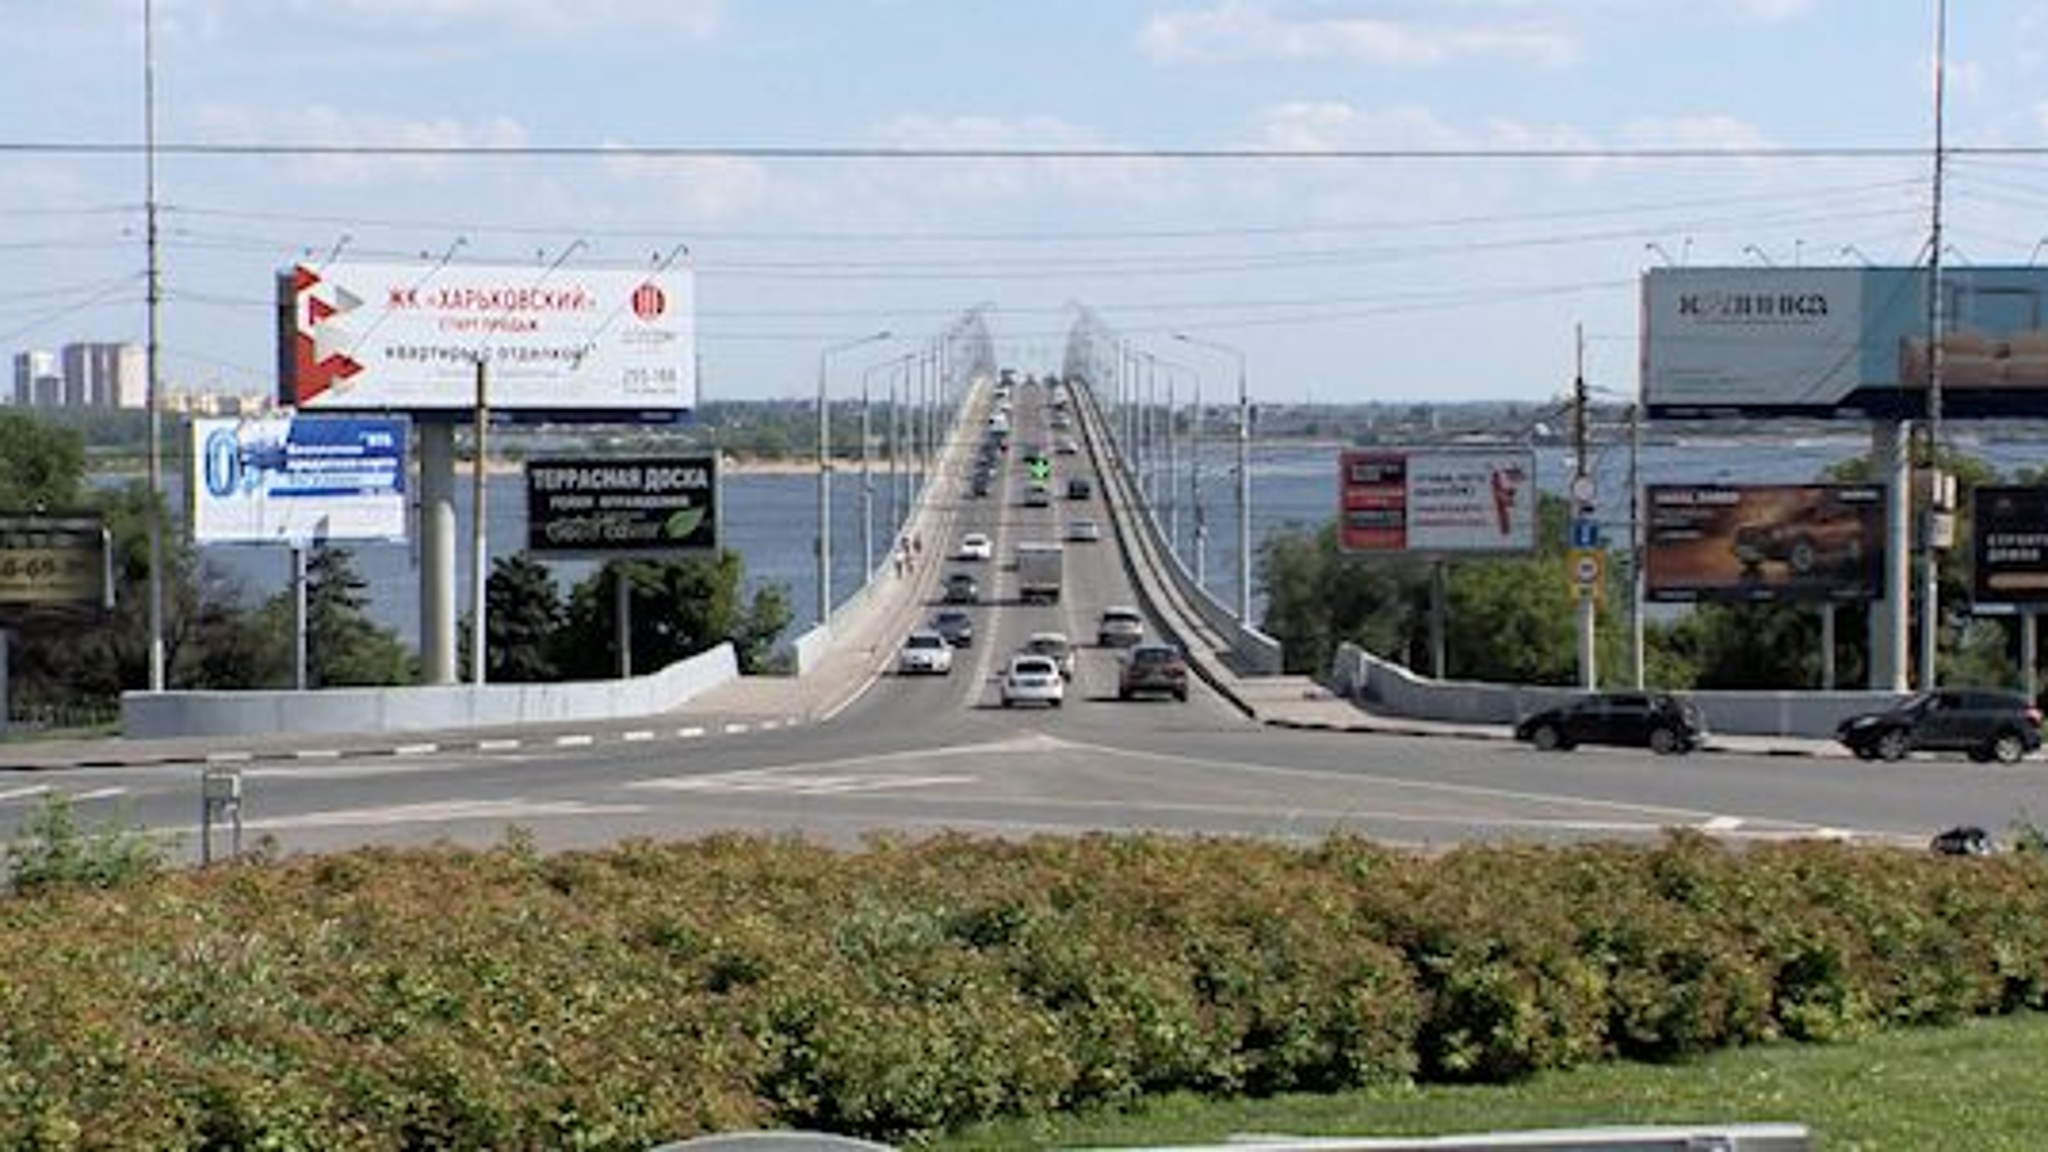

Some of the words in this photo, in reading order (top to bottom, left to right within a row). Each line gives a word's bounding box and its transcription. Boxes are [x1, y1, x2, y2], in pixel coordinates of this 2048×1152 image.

[389, 286, 419, 310] ЖК
[531, 467, 642, 491] ТЕРРАСНАЯ
[645, 467, 708, 493] ДОСКА
